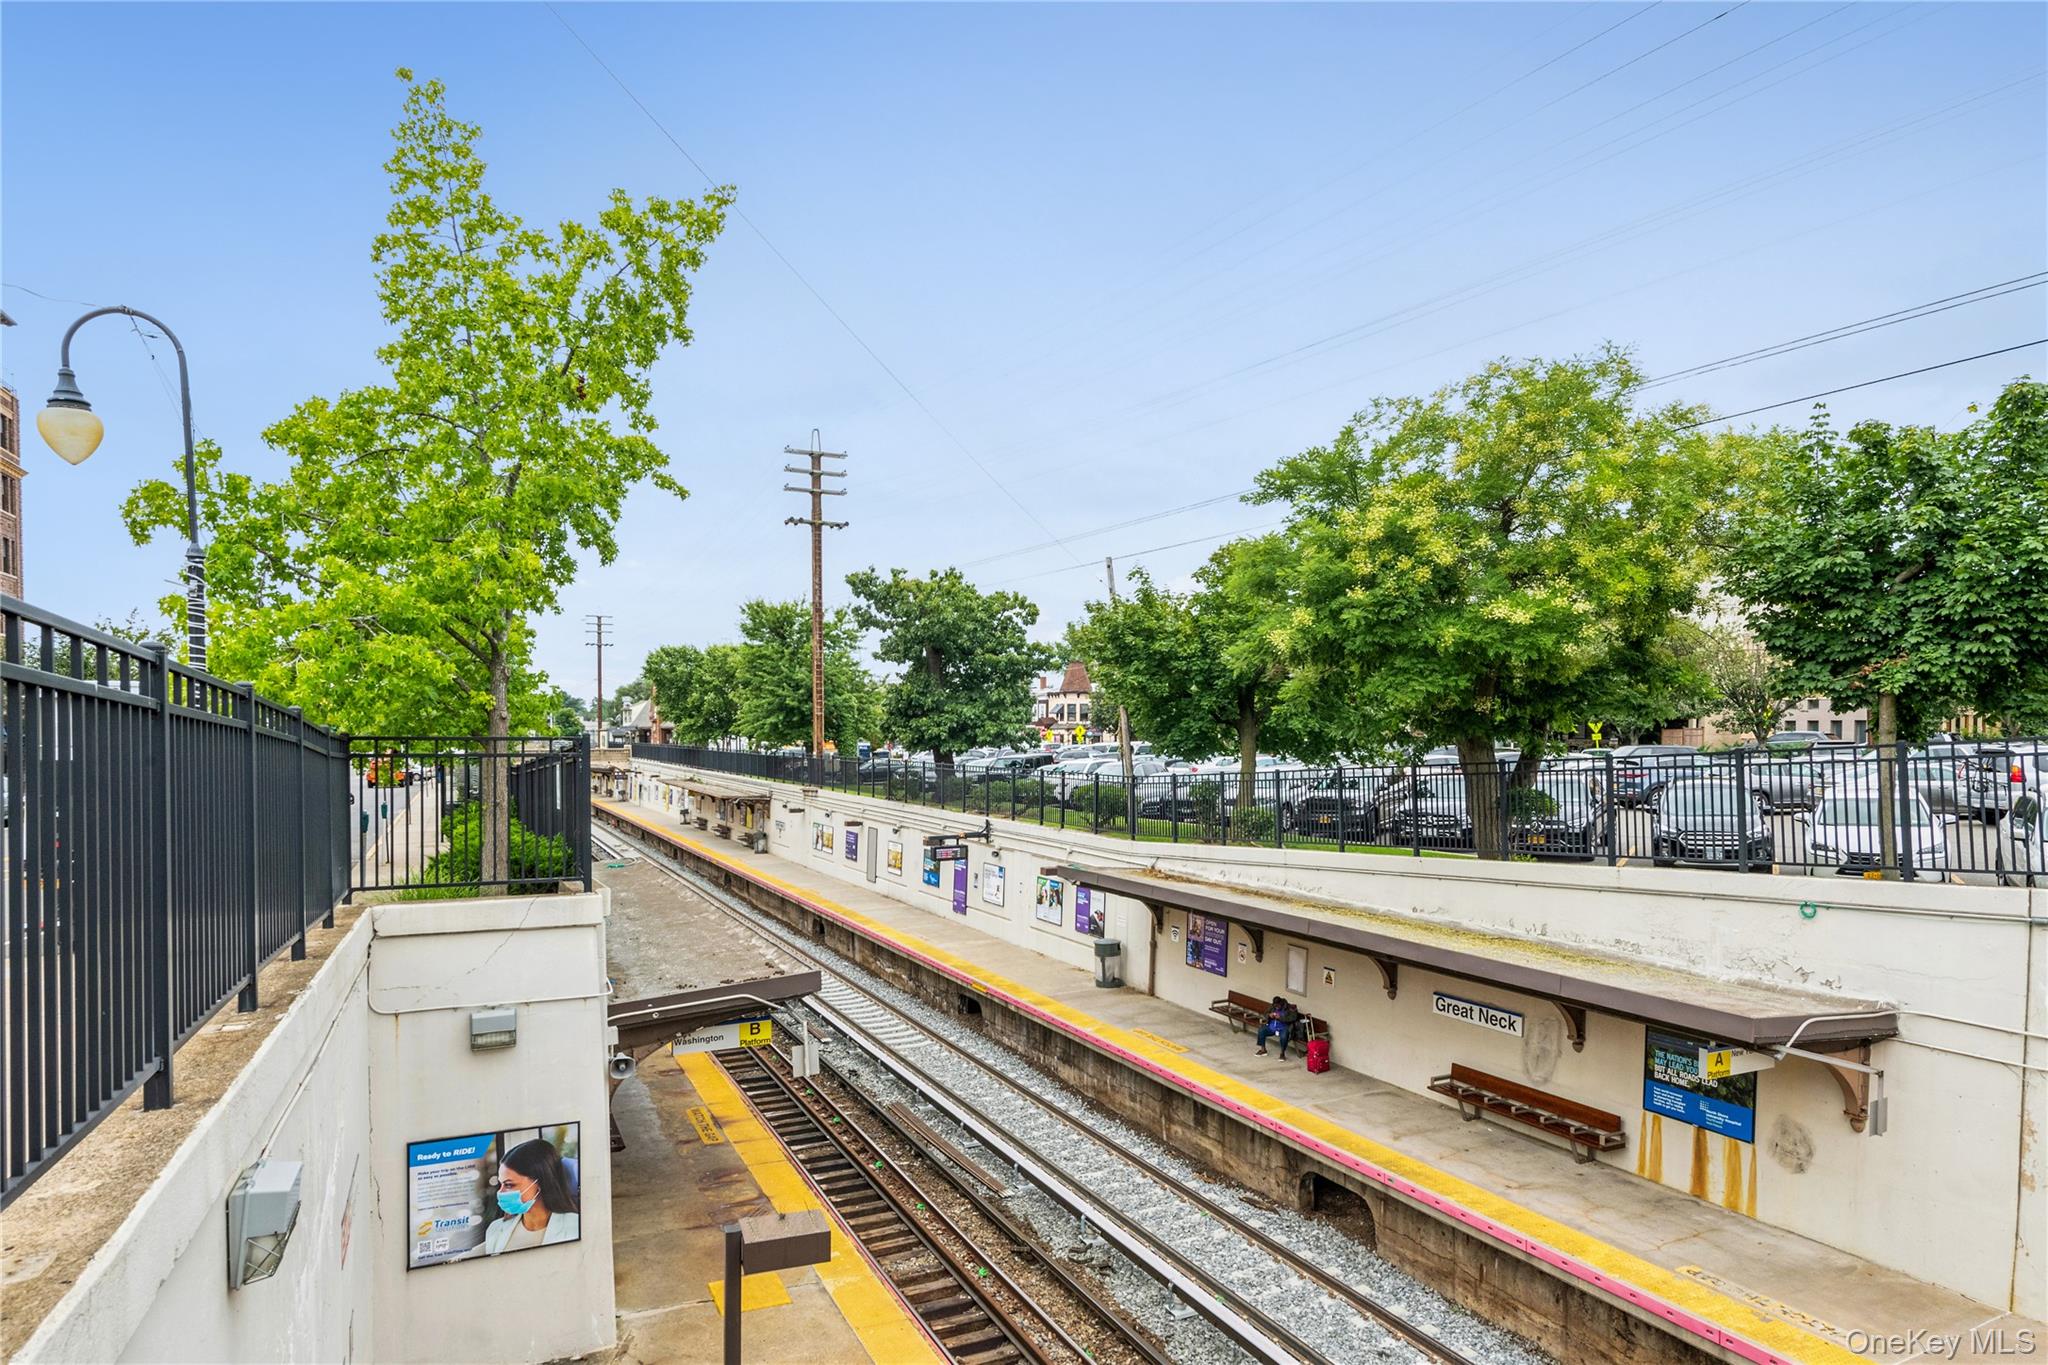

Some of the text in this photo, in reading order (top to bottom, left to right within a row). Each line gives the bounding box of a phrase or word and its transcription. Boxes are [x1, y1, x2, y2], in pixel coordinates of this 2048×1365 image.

[1435, 997, 1517, 1032] Great Neck
[750, 1022, 761, 1035] B
[674, 1034, 724, 1046] Washington
[740, 1038, 771, 1046] Platform
[1655, 1049, 1666, 1059] THE
[1667, 1053, 1693, 1066] NATION'S
[1715, 1053, 1724, 1067] A
[1655, 1058, 1667, 1067] MAY
[1668, 1061, 1684, 1071] LEAD
[1654, 1064, 1718, 1088] BUT ALL ROADS LEAD
[1654, 1072, 1691, 1088] BACK HOME.
[1708, 1069, 1731, 1078] Platform
[417, 1152, 441, 1161] Ready
[453, 1146, 476, 1156] RIDE!
[435, 1216, 470, 1228] Transit
